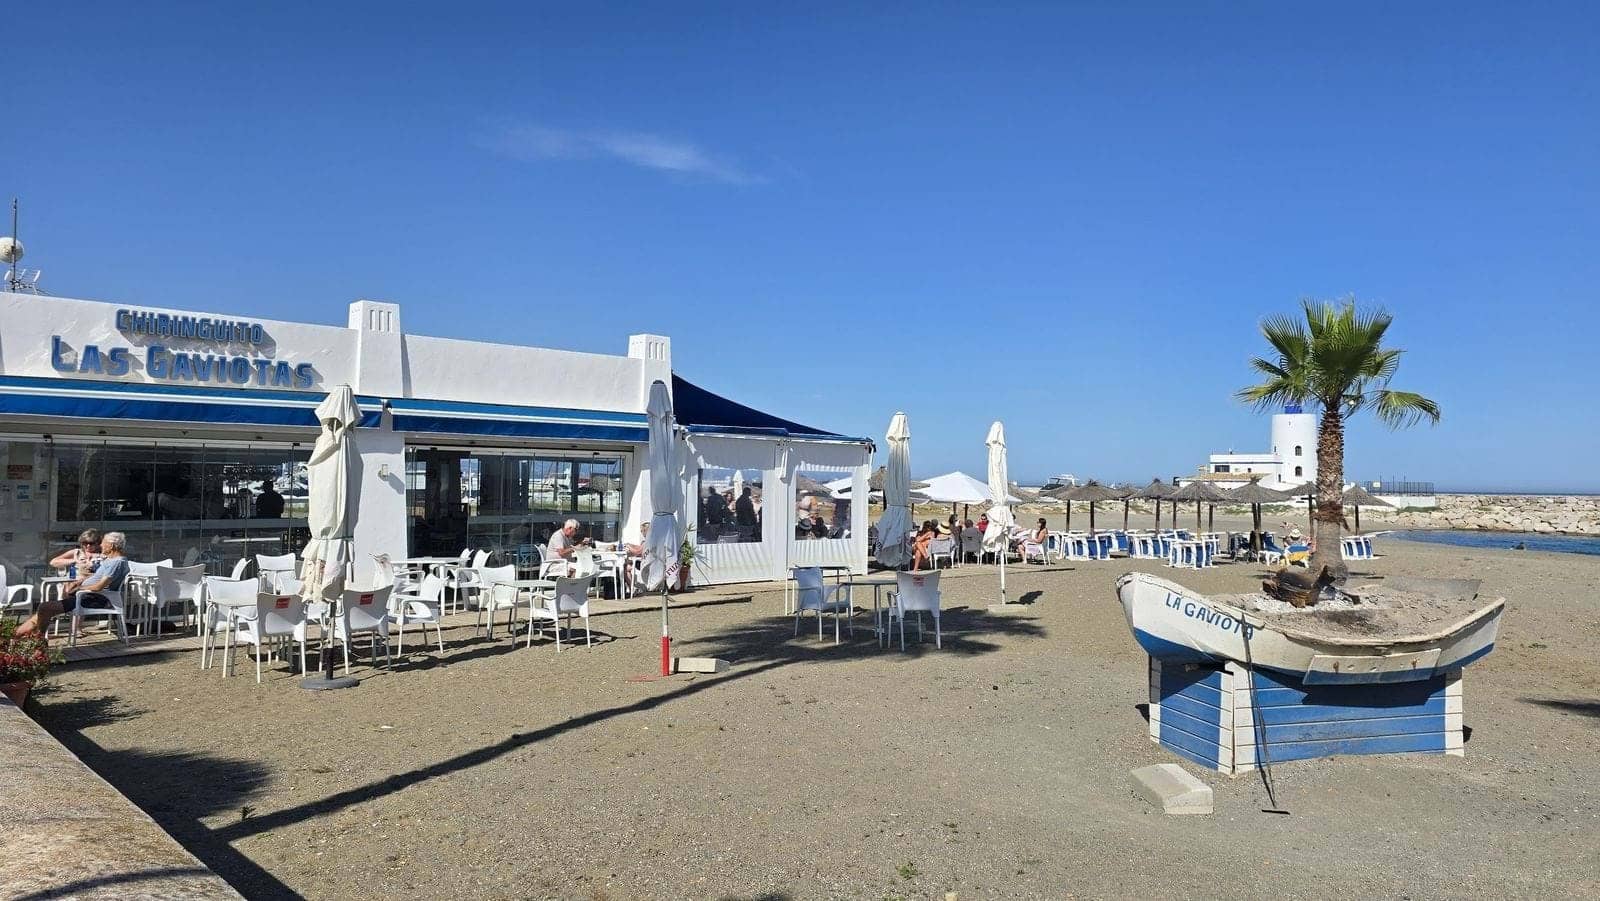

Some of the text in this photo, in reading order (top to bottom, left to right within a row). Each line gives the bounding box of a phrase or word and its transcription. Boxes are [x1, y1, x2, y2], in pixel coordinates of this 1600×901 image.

[116, 309, 264, 345] CHIRINGUITO
[51, 334, 314, 388] LAS GAVIOTAS
[1165, 592, 1254, 640] LA GAVIOTA
